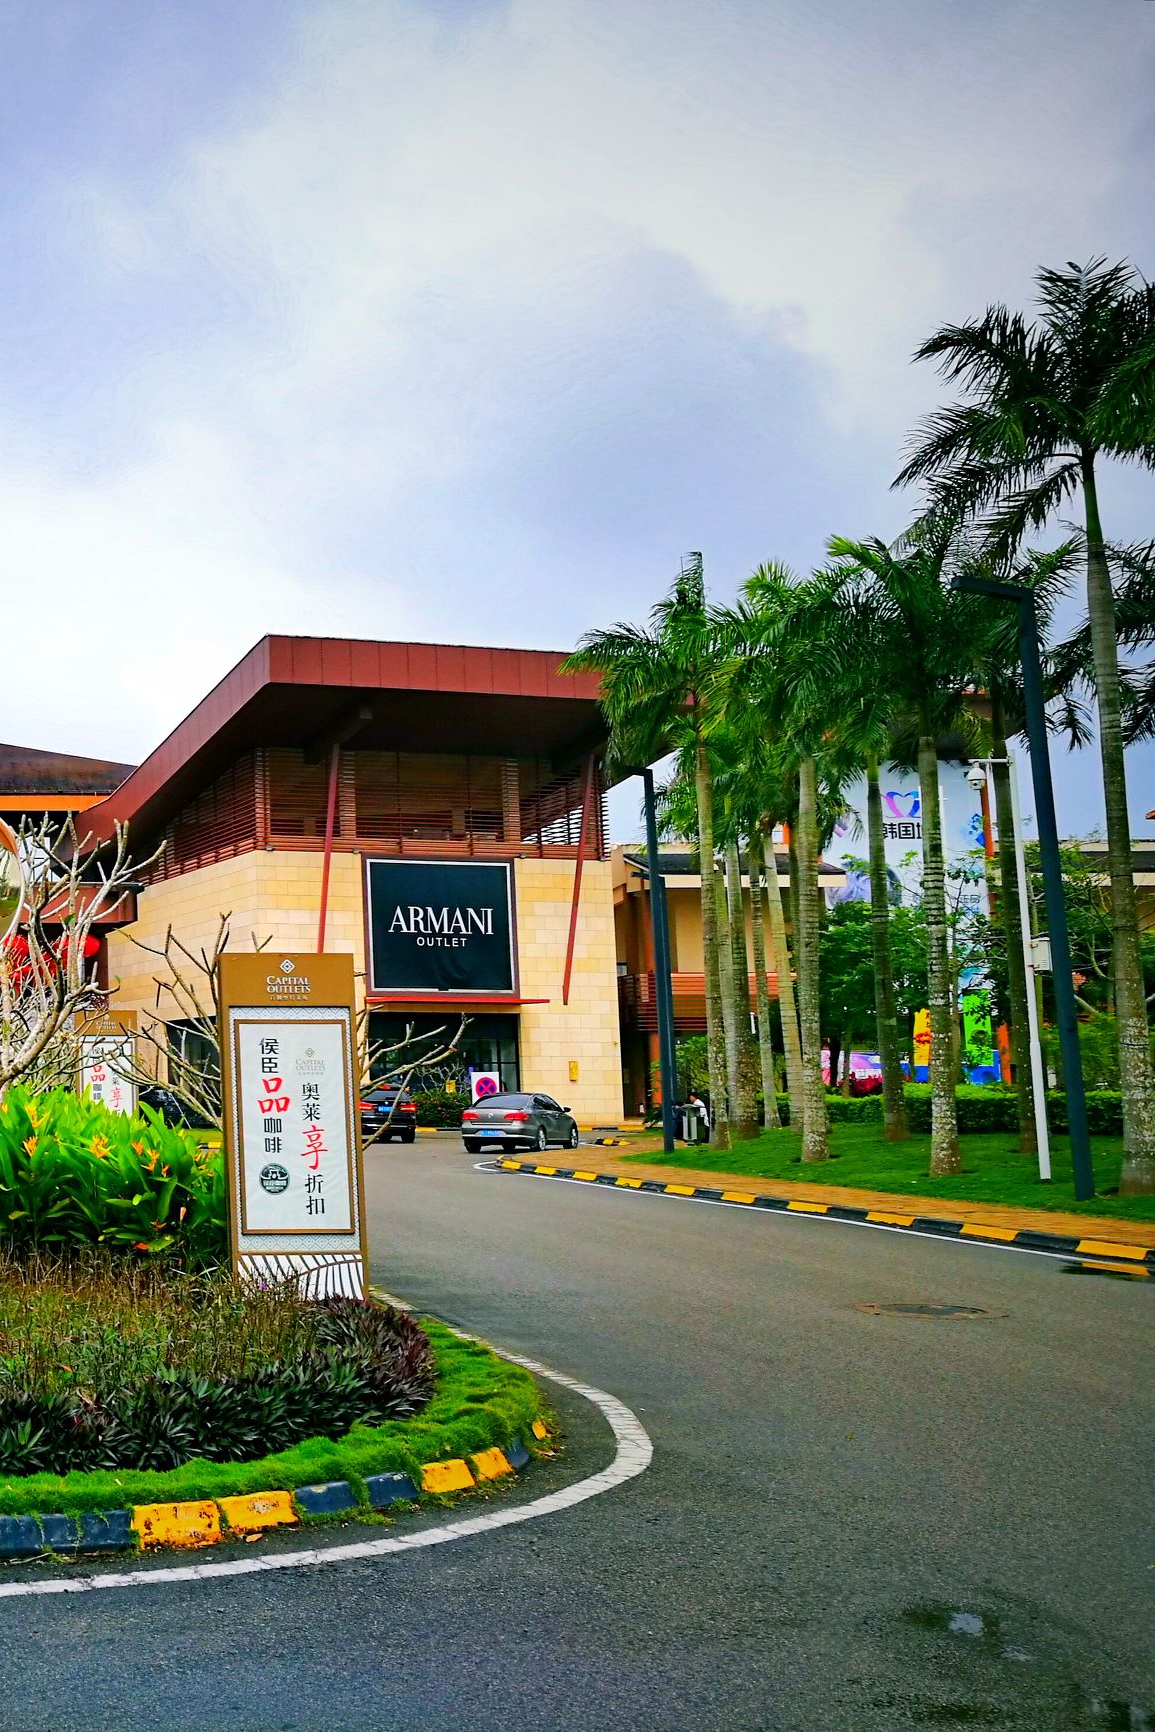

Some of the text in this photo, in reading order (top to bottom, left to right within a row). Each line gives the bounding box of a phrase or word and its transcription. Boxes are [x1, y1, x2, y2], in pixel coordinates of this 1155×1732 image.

[388, 905, 494, 935] ARMANI
[416, 937, 467, 947] OUTLET
[267, 976, 310, 985] CAPITAL
[258, 1038, 290, 1153] 侯臣品咖啡
[301, 1083, 328, 1215] 奥莱享折扣
